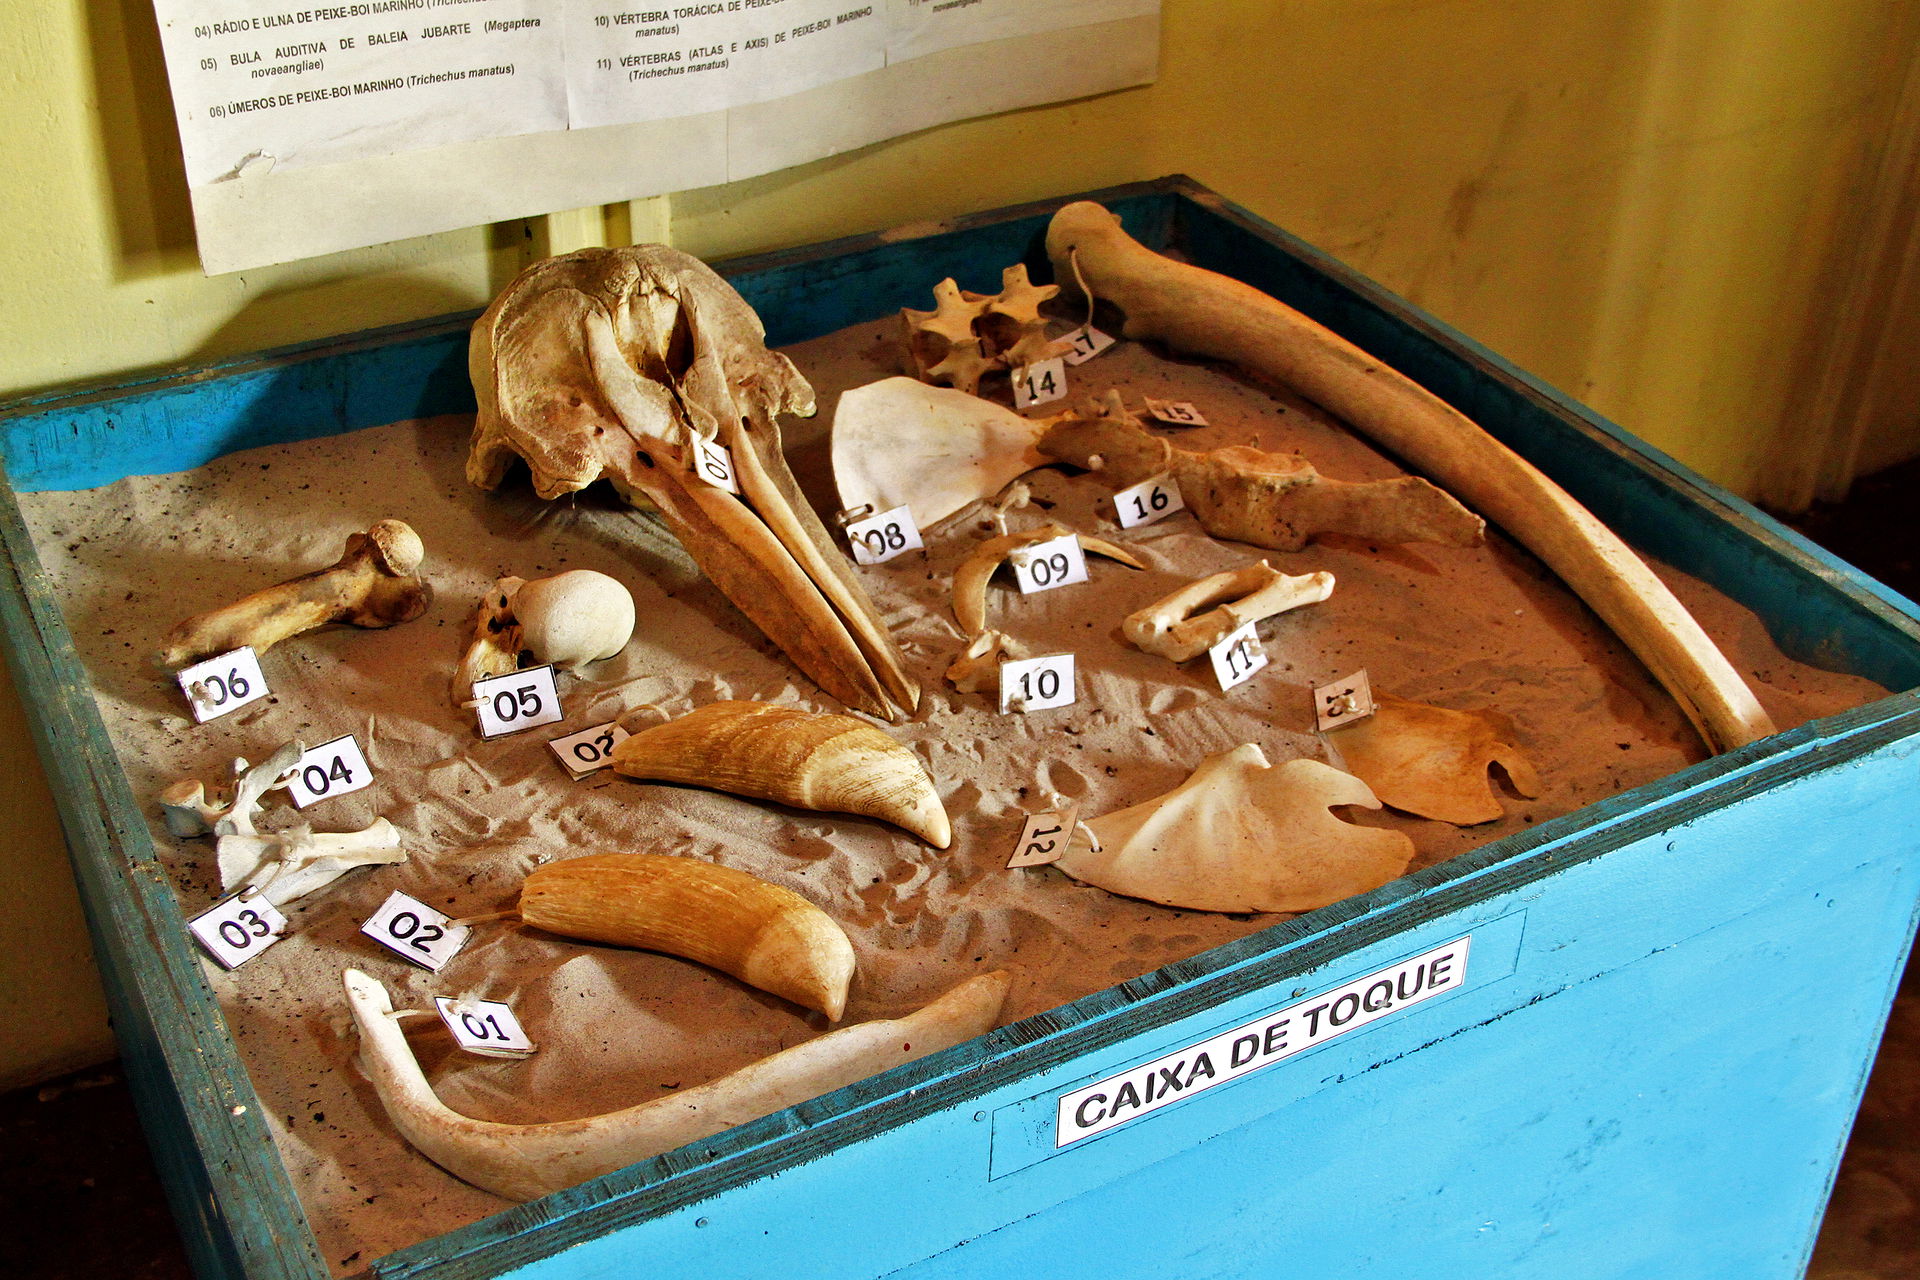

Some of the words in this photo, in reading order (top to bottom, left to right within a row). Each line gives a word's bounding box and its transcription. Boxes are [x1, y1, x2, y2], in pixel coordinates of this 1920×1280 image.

[194, 26, 212, 39] 04)
[214, 19, 250, 35] RÁDIO
[253, 18, 260, 29] E
[263, 14, 294, 29] ULNA
[297, 12, 312, 23] DE
[315, 4, 370, 21] PEIXE-BOI
[373, 0, 424, 14] MARINHO
[594, 15, 610, 29] 10)
[613, 10, 670, 25] VÉRTEBRA
[673, 3, 724, 19] TORÁCICA
[728, 1, 741, 12] DE
[635, 24, 680, 38] manatus)
[201, 58, 218, 71] 05)
[230, 51, 262, 66] BULA
[275, 41, 327, 59] AUDITIVA
[340, 38, 355, 50] DE
[368, 30, 408, 46] BALEIA
[421, 23, 471, 39] JUBARTE
[484, 18, 541, 34] (Megaptera
[596, 58, 612, 71] 11)
[619, 51, 681, 67] VÉRTEBRAS
[688, 45, 724, 61] (ATLAS
[731, 43, 737, 53] E
[745, 37, 769, 50] AXIS)
[775, 32, 786, 44] DE
[792, 19, 831, 38] PEIXE-BOI
[836, 6, 873, 25] MARINHO
[251, 58, 324, 79] novaeangliae)
[629, 67, 685, 83] (Trichechus
[687, 58, 729, 74] manatus)
[210, 105, 226, 118] 06)
[228, 96, 276, 115] ÚMEROS
[279, 94, 294, 106] DE
[297, 85, 351, 104] PEIXE-BOI
[354, 77, 404, 95] MARINHO
[406, 71, 466, 89] (Trichechus
[468, 63, 515, 79] manatus)
[1026, 370, 1056, 400] 14
[701, 445, 728, 480] 07
[1133, 486, 1168, 519] 16
[865, 522, 906, 556] 08
[1031, 553, 1069, 586] 09
[1226, 641, 1253, 679] 11
[204, 667, 249, 706] 06
[1020, 669, 1060, 701] 10
[493, 684, 542, 722] 05
[303, 755, 353, 796] 04
[1024, 825, 1062, 856] 12
[219, 909, 271, 949] 03
[388, 912, 444, 953] 02
[461, 1013, 511, 1041] 01
[1075, 1053, 1215, 1130] CAIXA
[1230, 1018, 1289, 1069] DE
[1303, 952, 1454, 1039] TOQUE
